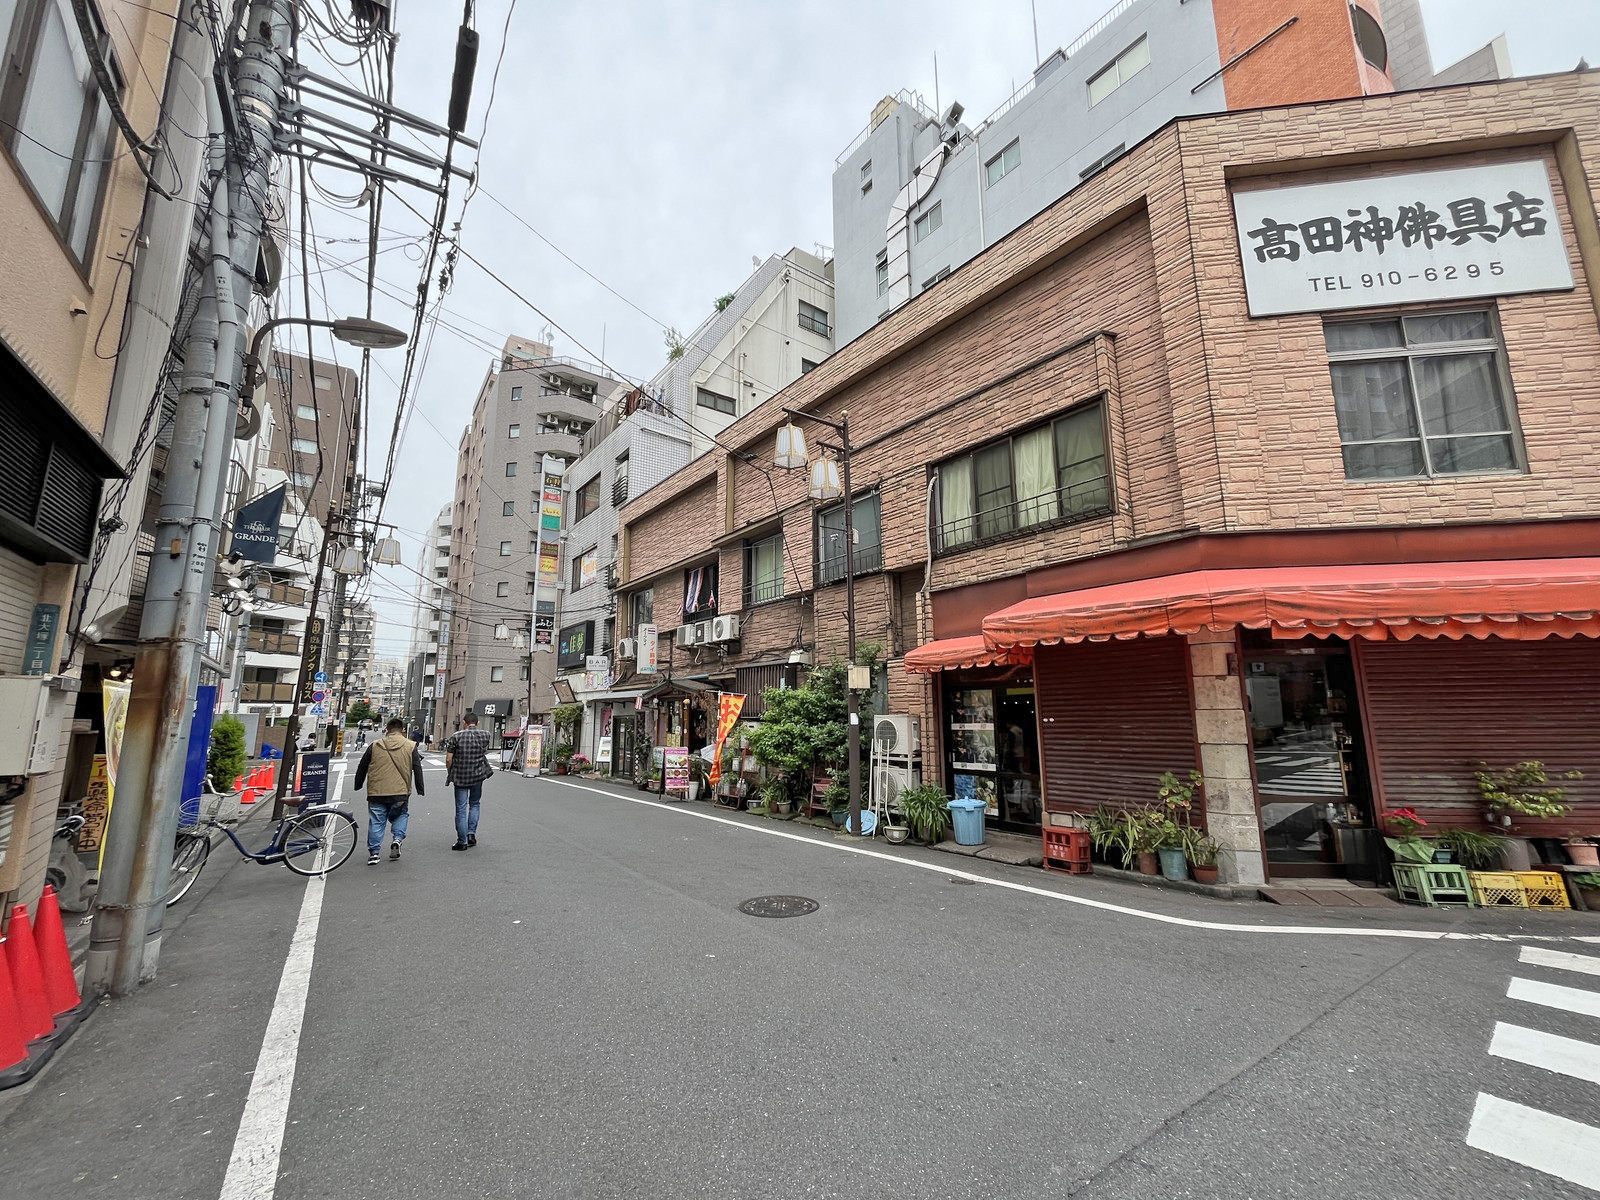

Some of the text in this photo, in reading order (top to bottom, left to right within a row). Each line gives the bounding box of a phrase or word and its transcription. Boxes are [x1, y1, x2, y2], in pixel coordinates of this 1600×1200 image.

[1308, 261, 1505, 292] TEL 910-6295
[234, 532, 276, 544] GRANDE
[31, 613, 52, 669] 北大塚二丁目
[302, 769, 327, 777] GRANDE
